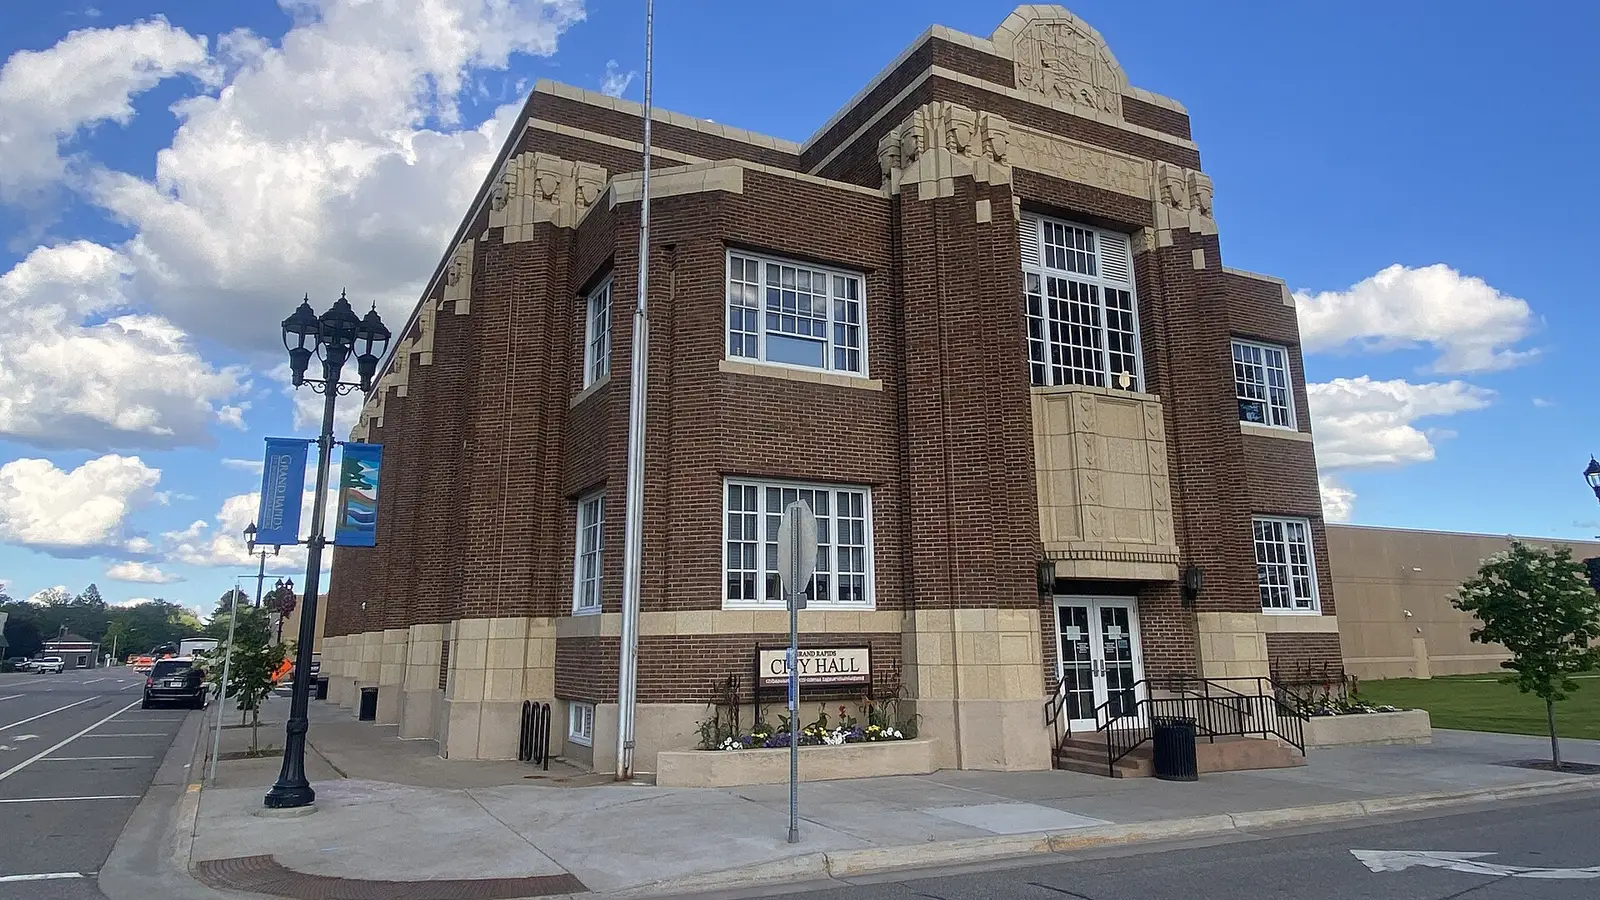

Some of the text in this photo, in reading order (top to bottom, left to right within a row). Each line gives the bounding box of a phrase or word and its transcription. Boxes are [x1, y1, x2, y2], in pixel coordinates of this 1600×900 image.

[278, 454, 292, 494] GRAND
[770, 657, 860, 675] CIY HALL
